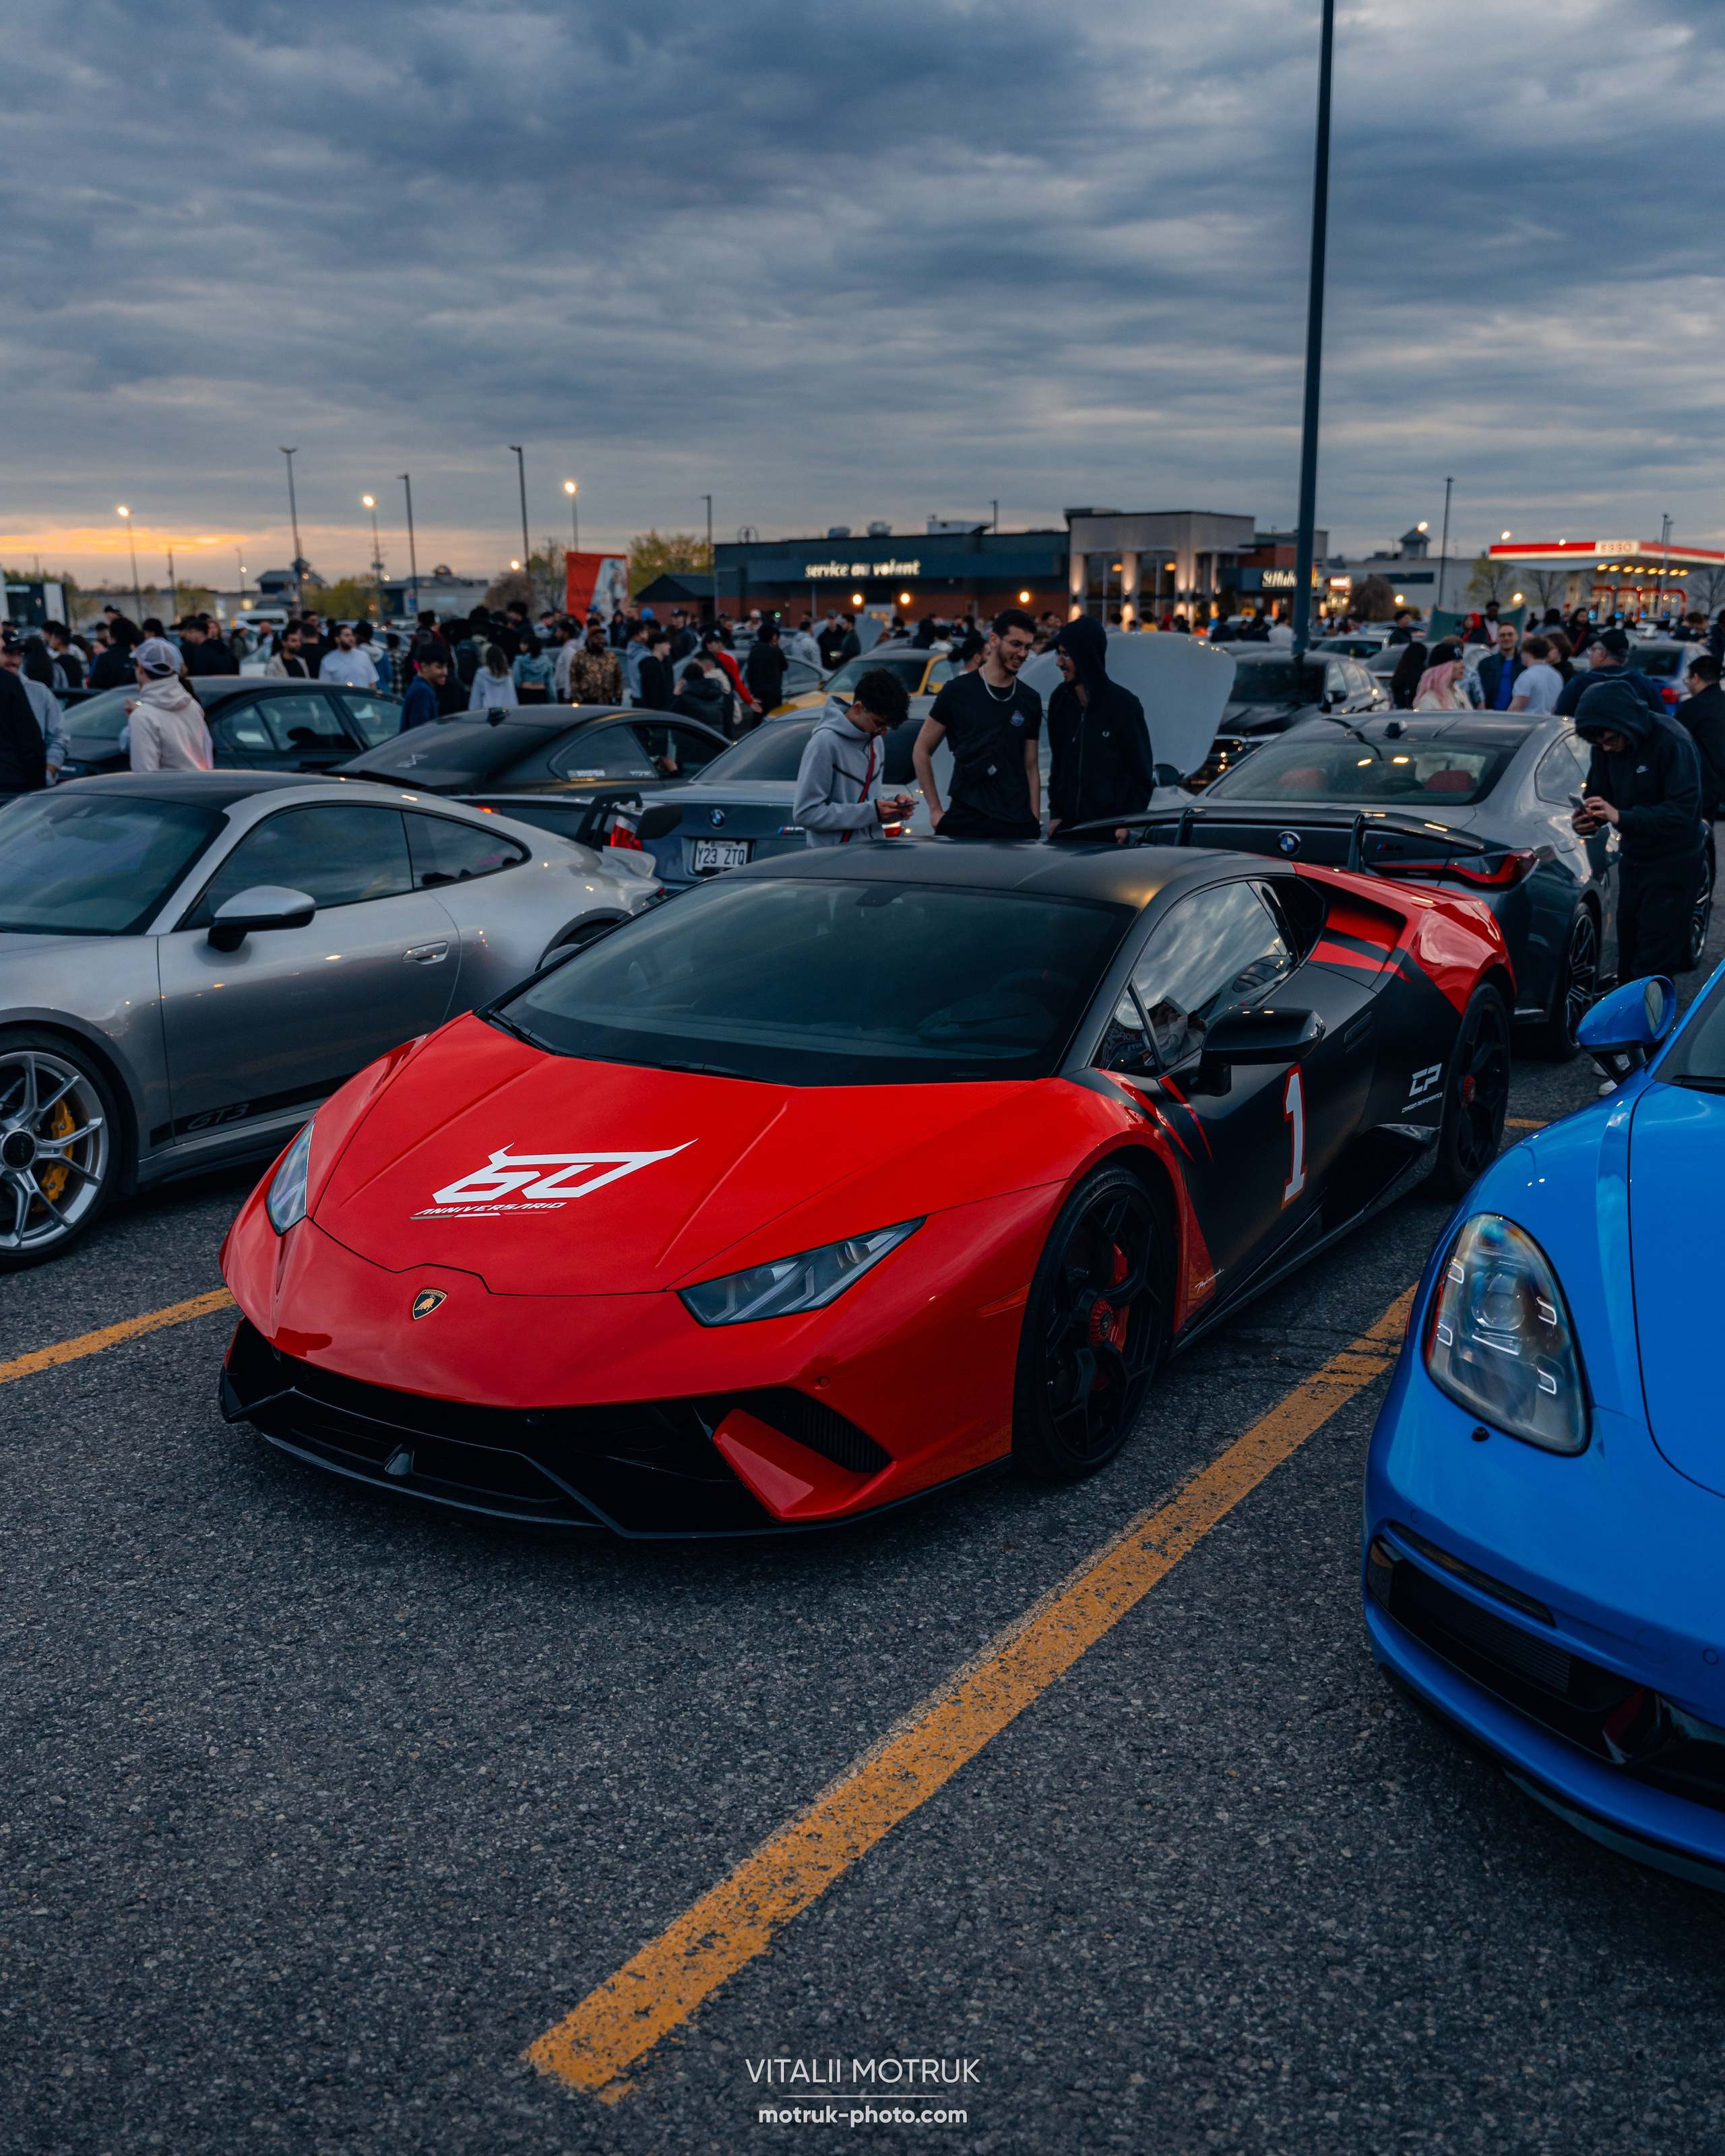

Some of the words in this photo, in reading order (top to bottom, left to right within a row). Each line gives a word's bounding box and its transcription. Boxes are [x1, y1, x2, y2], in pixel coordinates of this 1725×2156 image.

[1601, 542, 1633, 552] ESSO
[805, 560, 850, 577] service
[850, 563, 871, 577] au
[873, 559, 920, 576] volant
[697, 848, 717, 864] Y23
[187, 1103, 250, 1131] GT3
[1282, 1065, 1307, 1208] 1
[414, 1202, 568, 1215] ANNIVERSARIO
